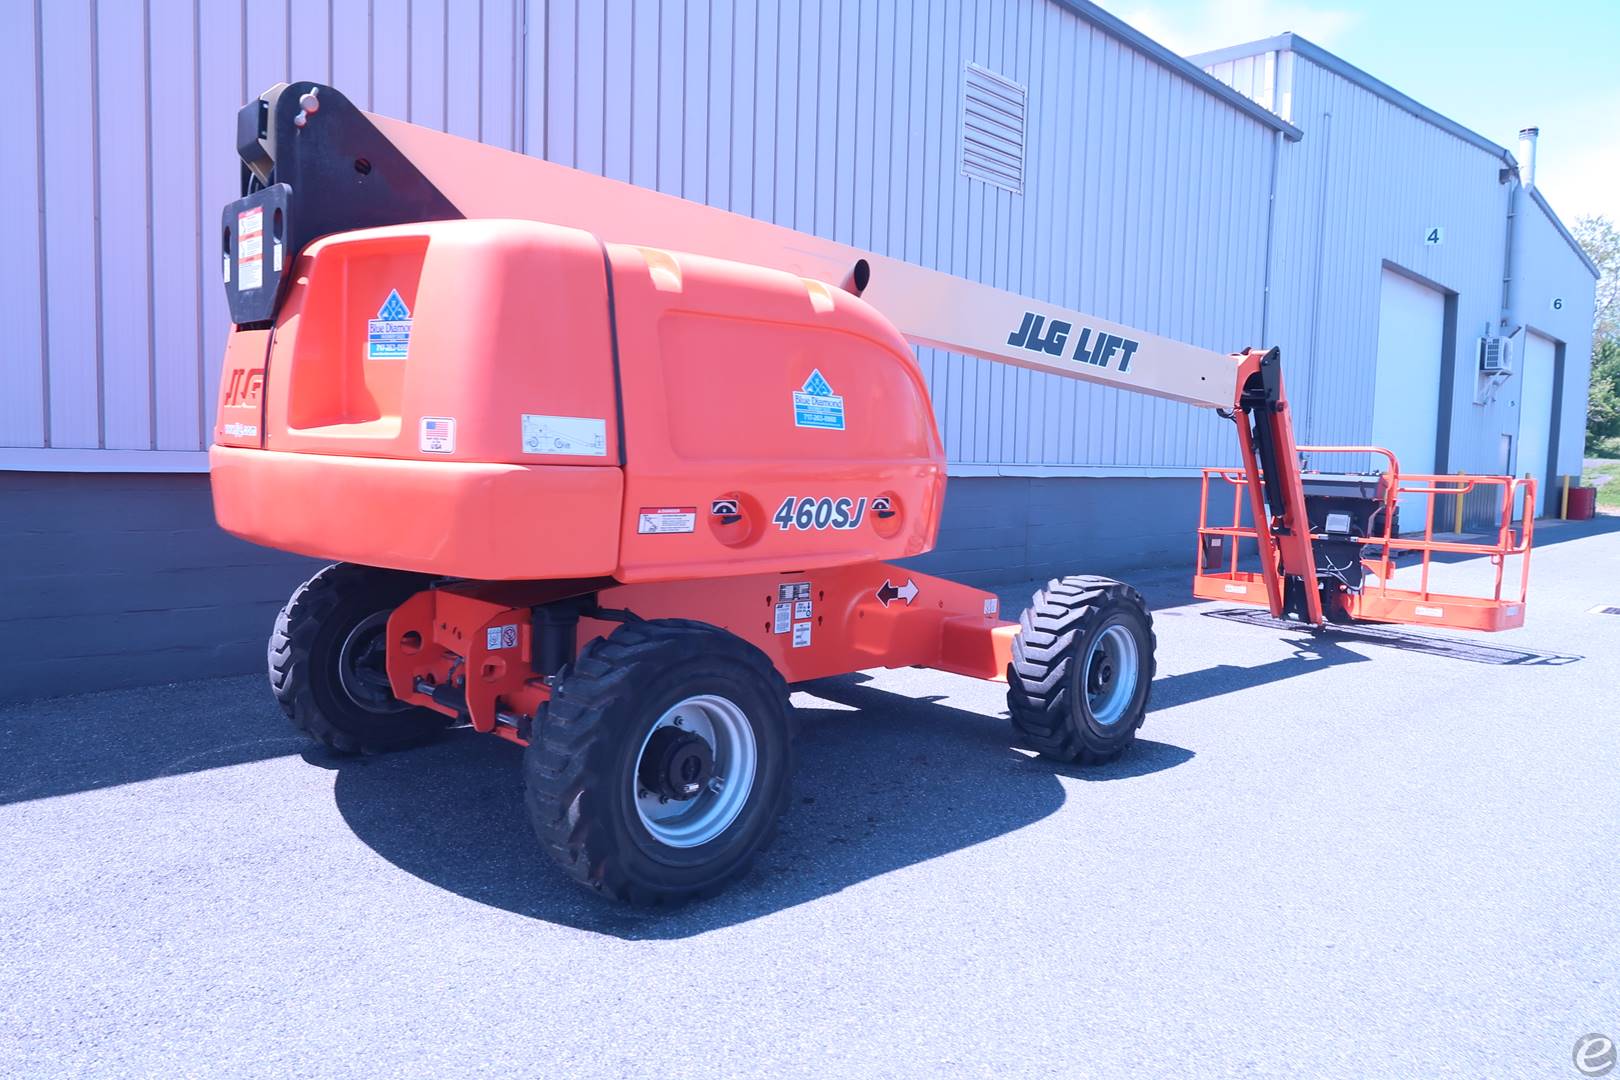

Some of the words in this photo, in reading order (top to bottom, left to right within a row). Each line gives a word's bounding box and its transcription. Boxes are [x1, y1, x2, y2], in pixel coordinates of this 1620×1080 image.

[1427, 228, 1440, 244] 4
[1553, 298, 1563, 310] 6
[369, 323, 385, 334] Blue
[1006, 311, 1073, 357] JLG
[1072, 327, 1139, 372] LIFT
[224, 368, 265, 407] JLG
[795, 395, 810, 405] Blue
[811, 396, 842, 408] Diamond
[773, 496, 867, 531] 460SJ
